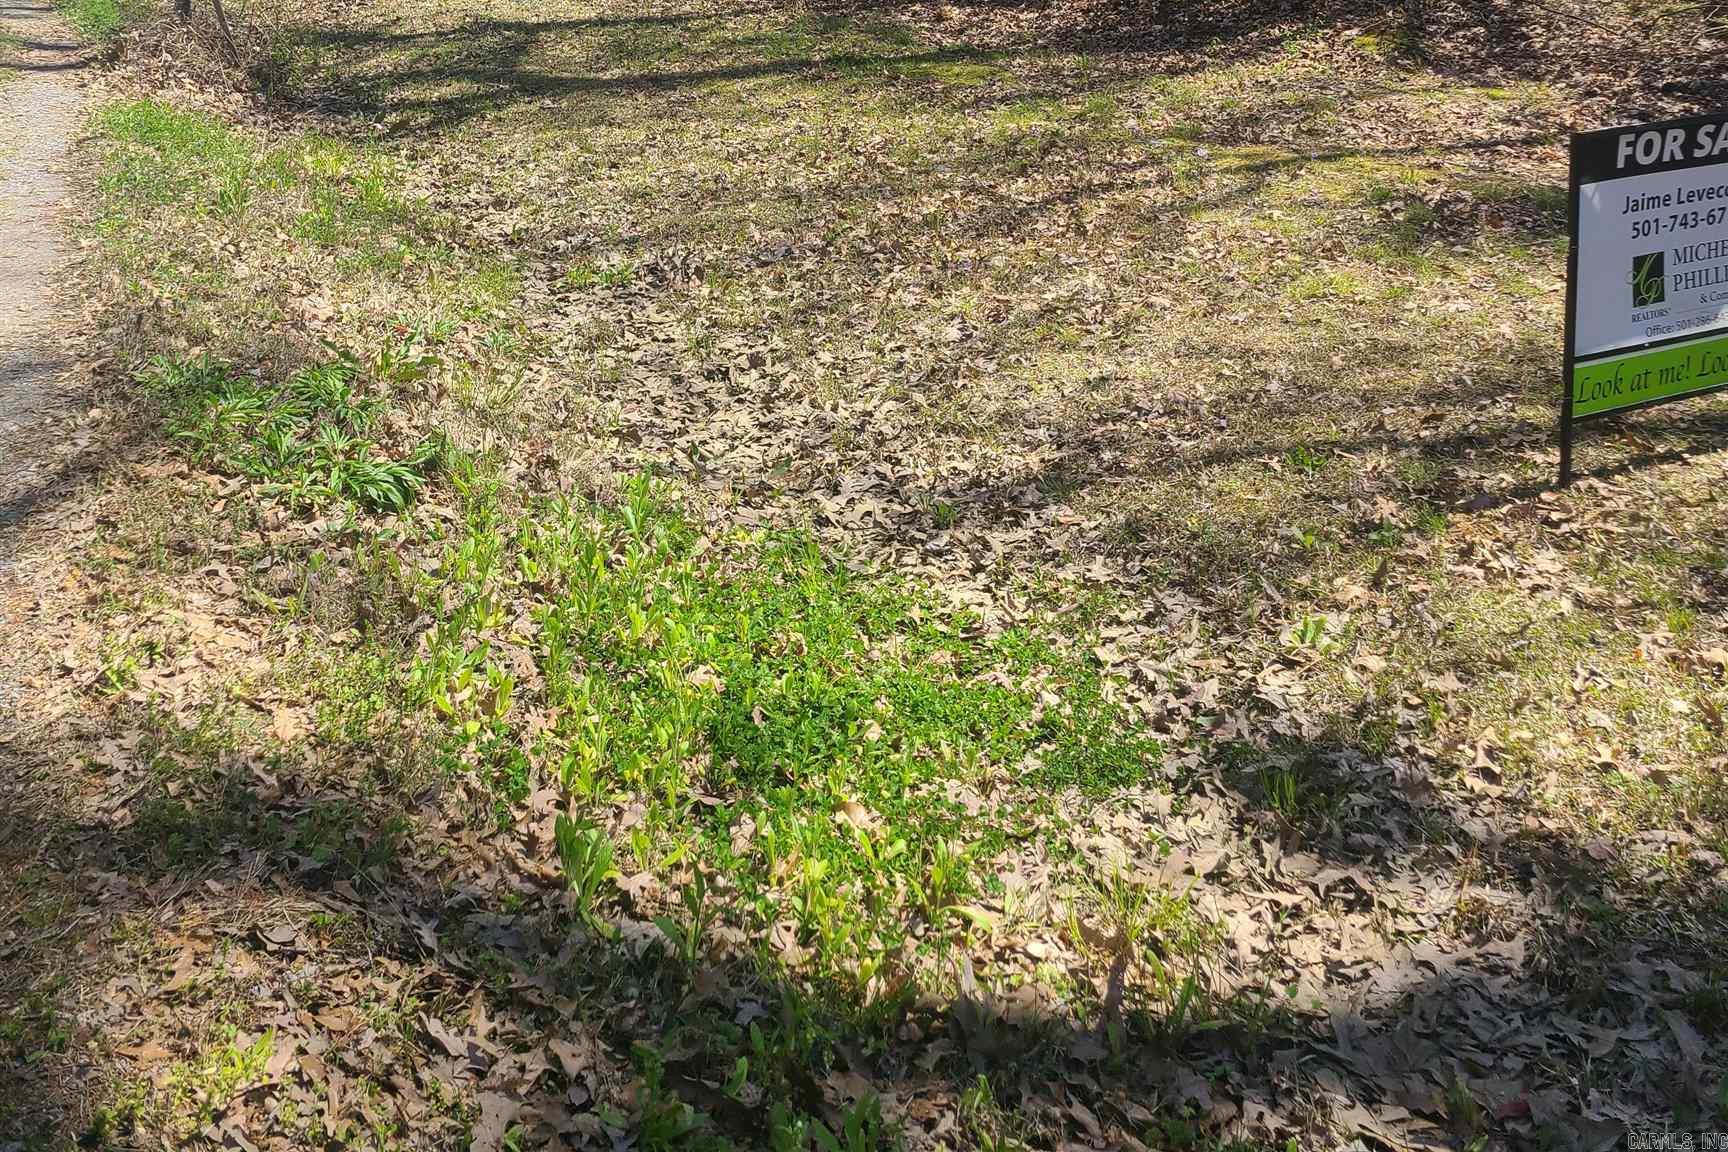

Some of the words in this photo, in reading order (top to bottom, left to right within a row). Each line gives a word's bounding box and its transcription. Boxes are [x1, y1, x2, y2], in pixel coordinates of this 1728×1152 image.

[1616, 128, 1686, 169] FOR
[1622, 193, 1672, 215] Jaime
[1631, 207, 1727, 239] 501-743-67
[1672, 240, 1728, 266] MICHE
[1575, 363, 1625, 404] Look
[1630, 368, 1653, 392] at
[1659, 355, 1691, 385] me!
